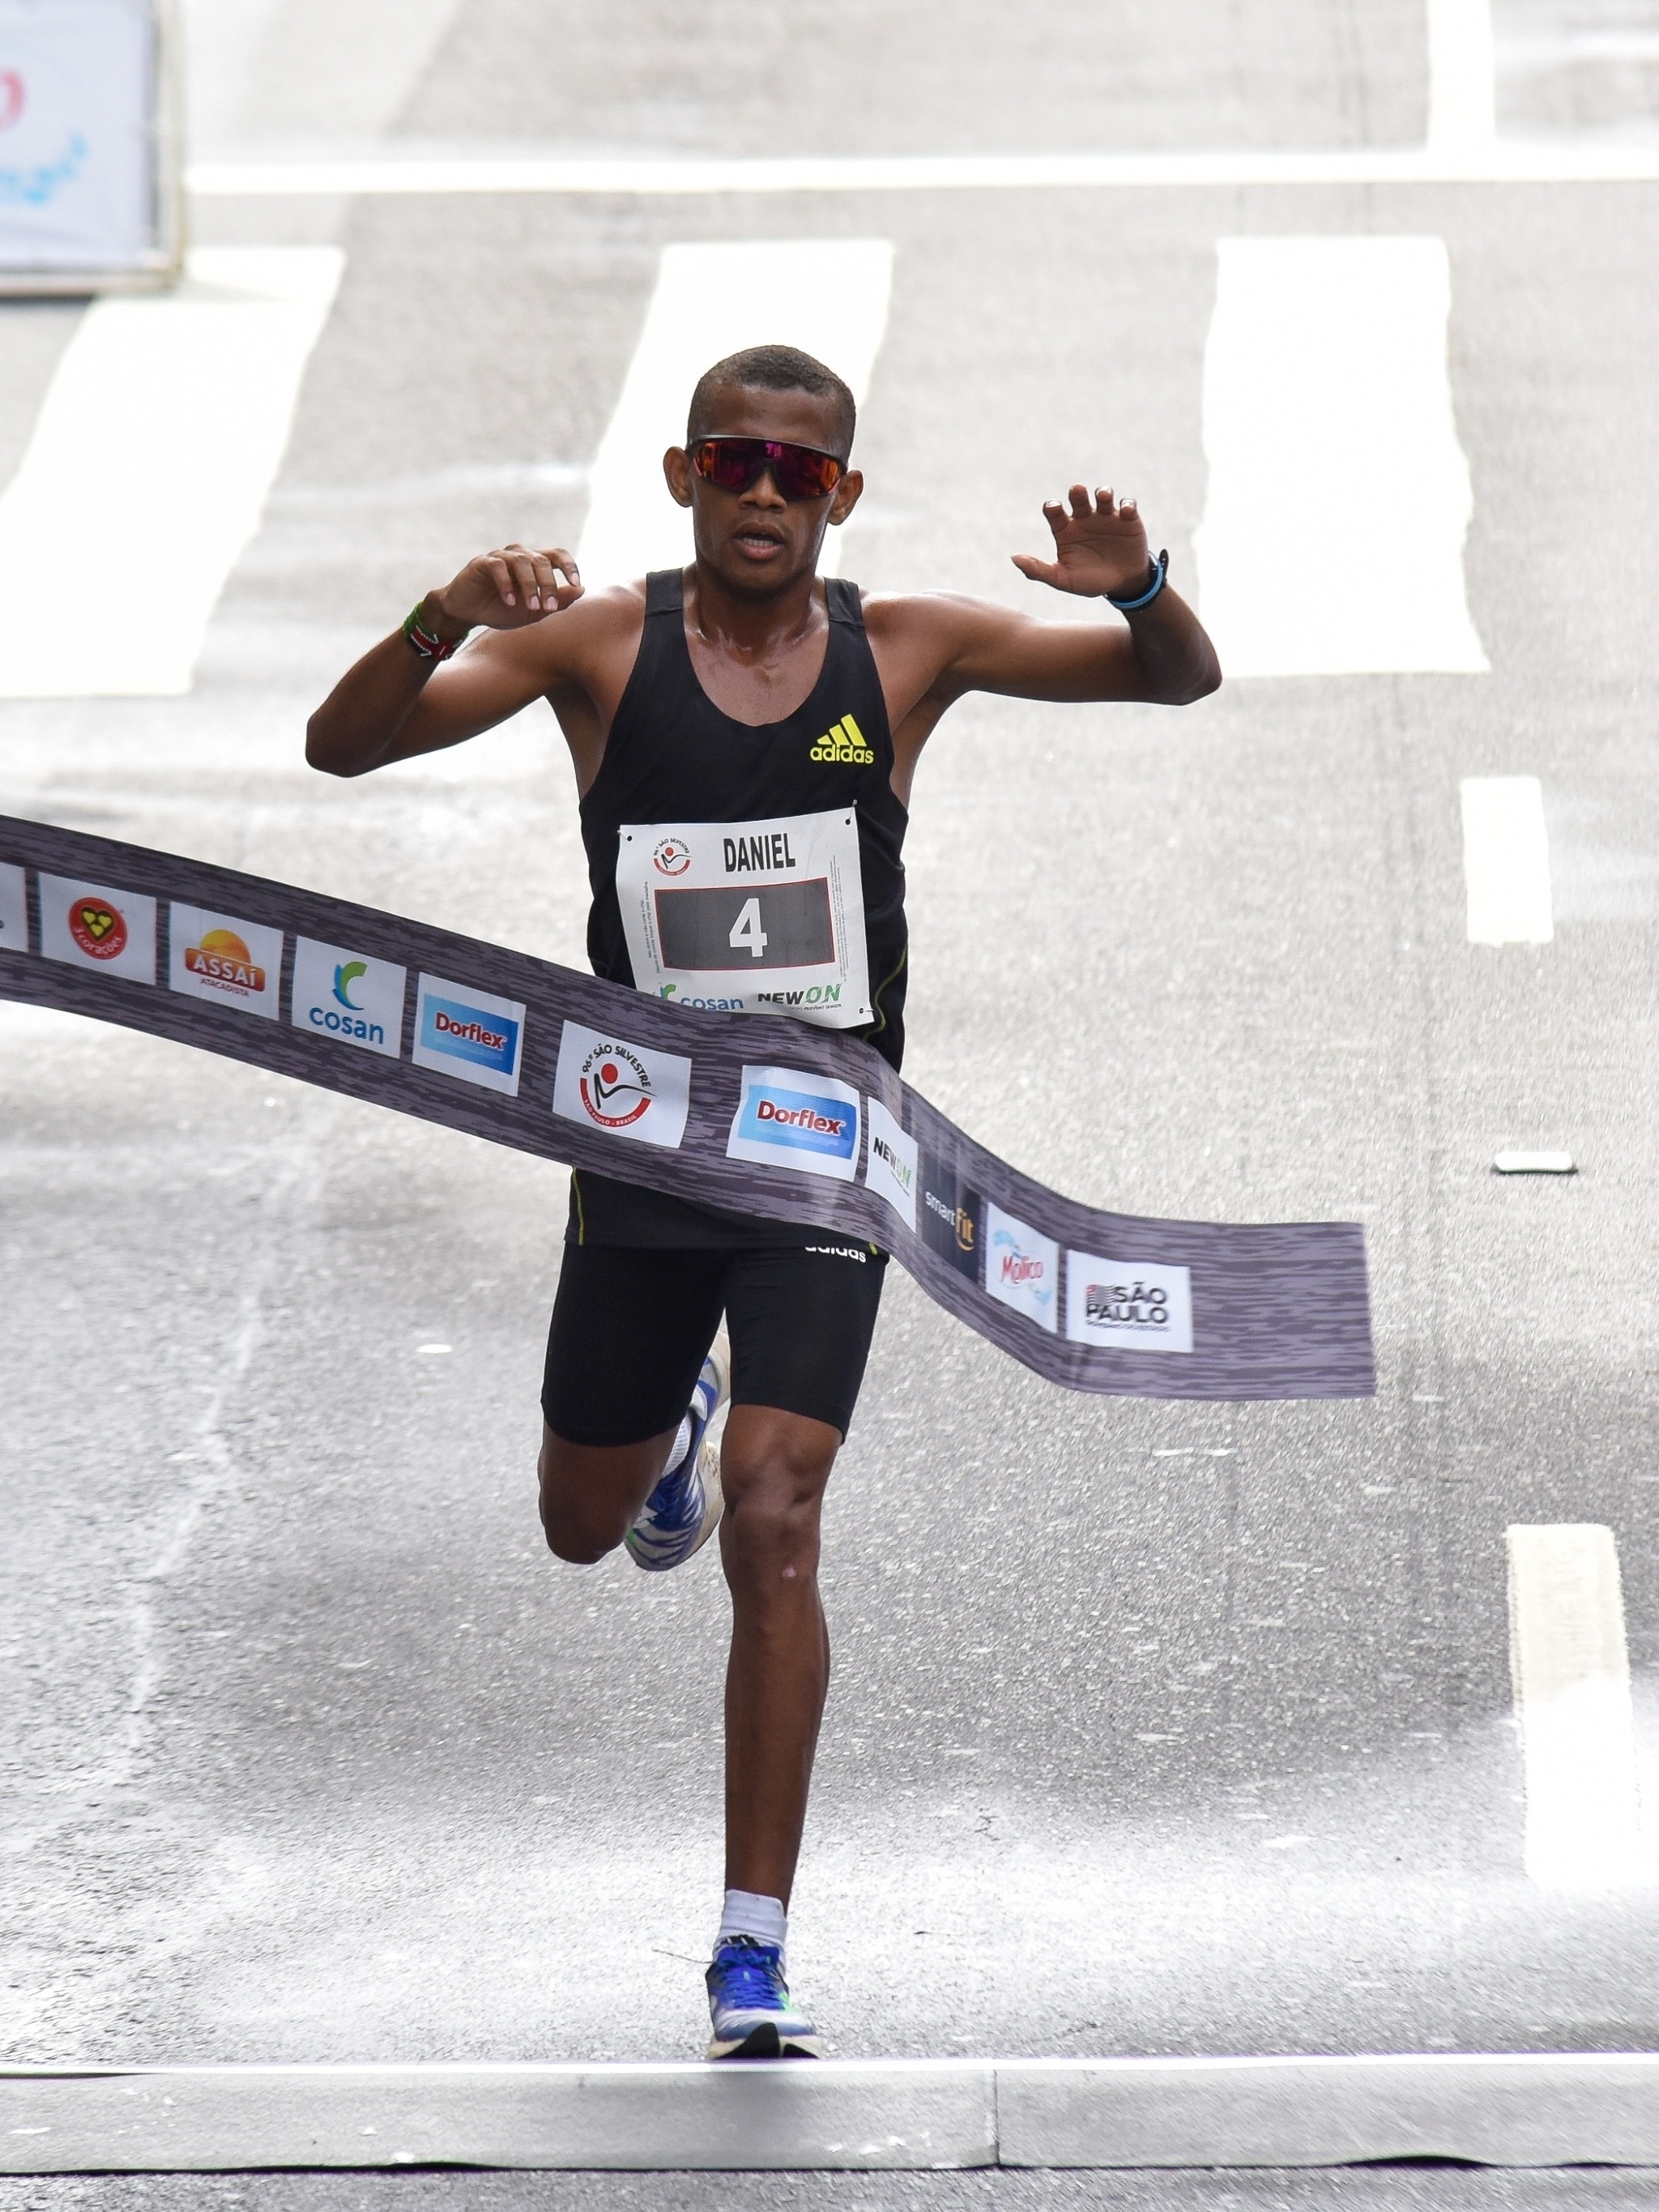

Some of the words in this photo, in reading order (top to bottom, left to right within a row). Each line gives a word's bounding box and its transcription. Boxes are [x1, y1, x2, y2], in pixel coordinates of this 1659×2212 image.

[810, 744, 874, 764] adidas
[723, 833, 795, 872] DANIEL
[729, 898, 768, 958] 4
[309, 1007, 384, 1044] cosan
[436, 1012, 503, 1050] Dorflex
[594, 1044, 612, 1058] SÃO
[615, 1046, 651, 1087] SILVESTRE
[757, 1100, 840, 1135] Dorflex
[1115, 1282, 1167, 1305] SÃO
[1086, 1304, 1169, 1324] PAULO
